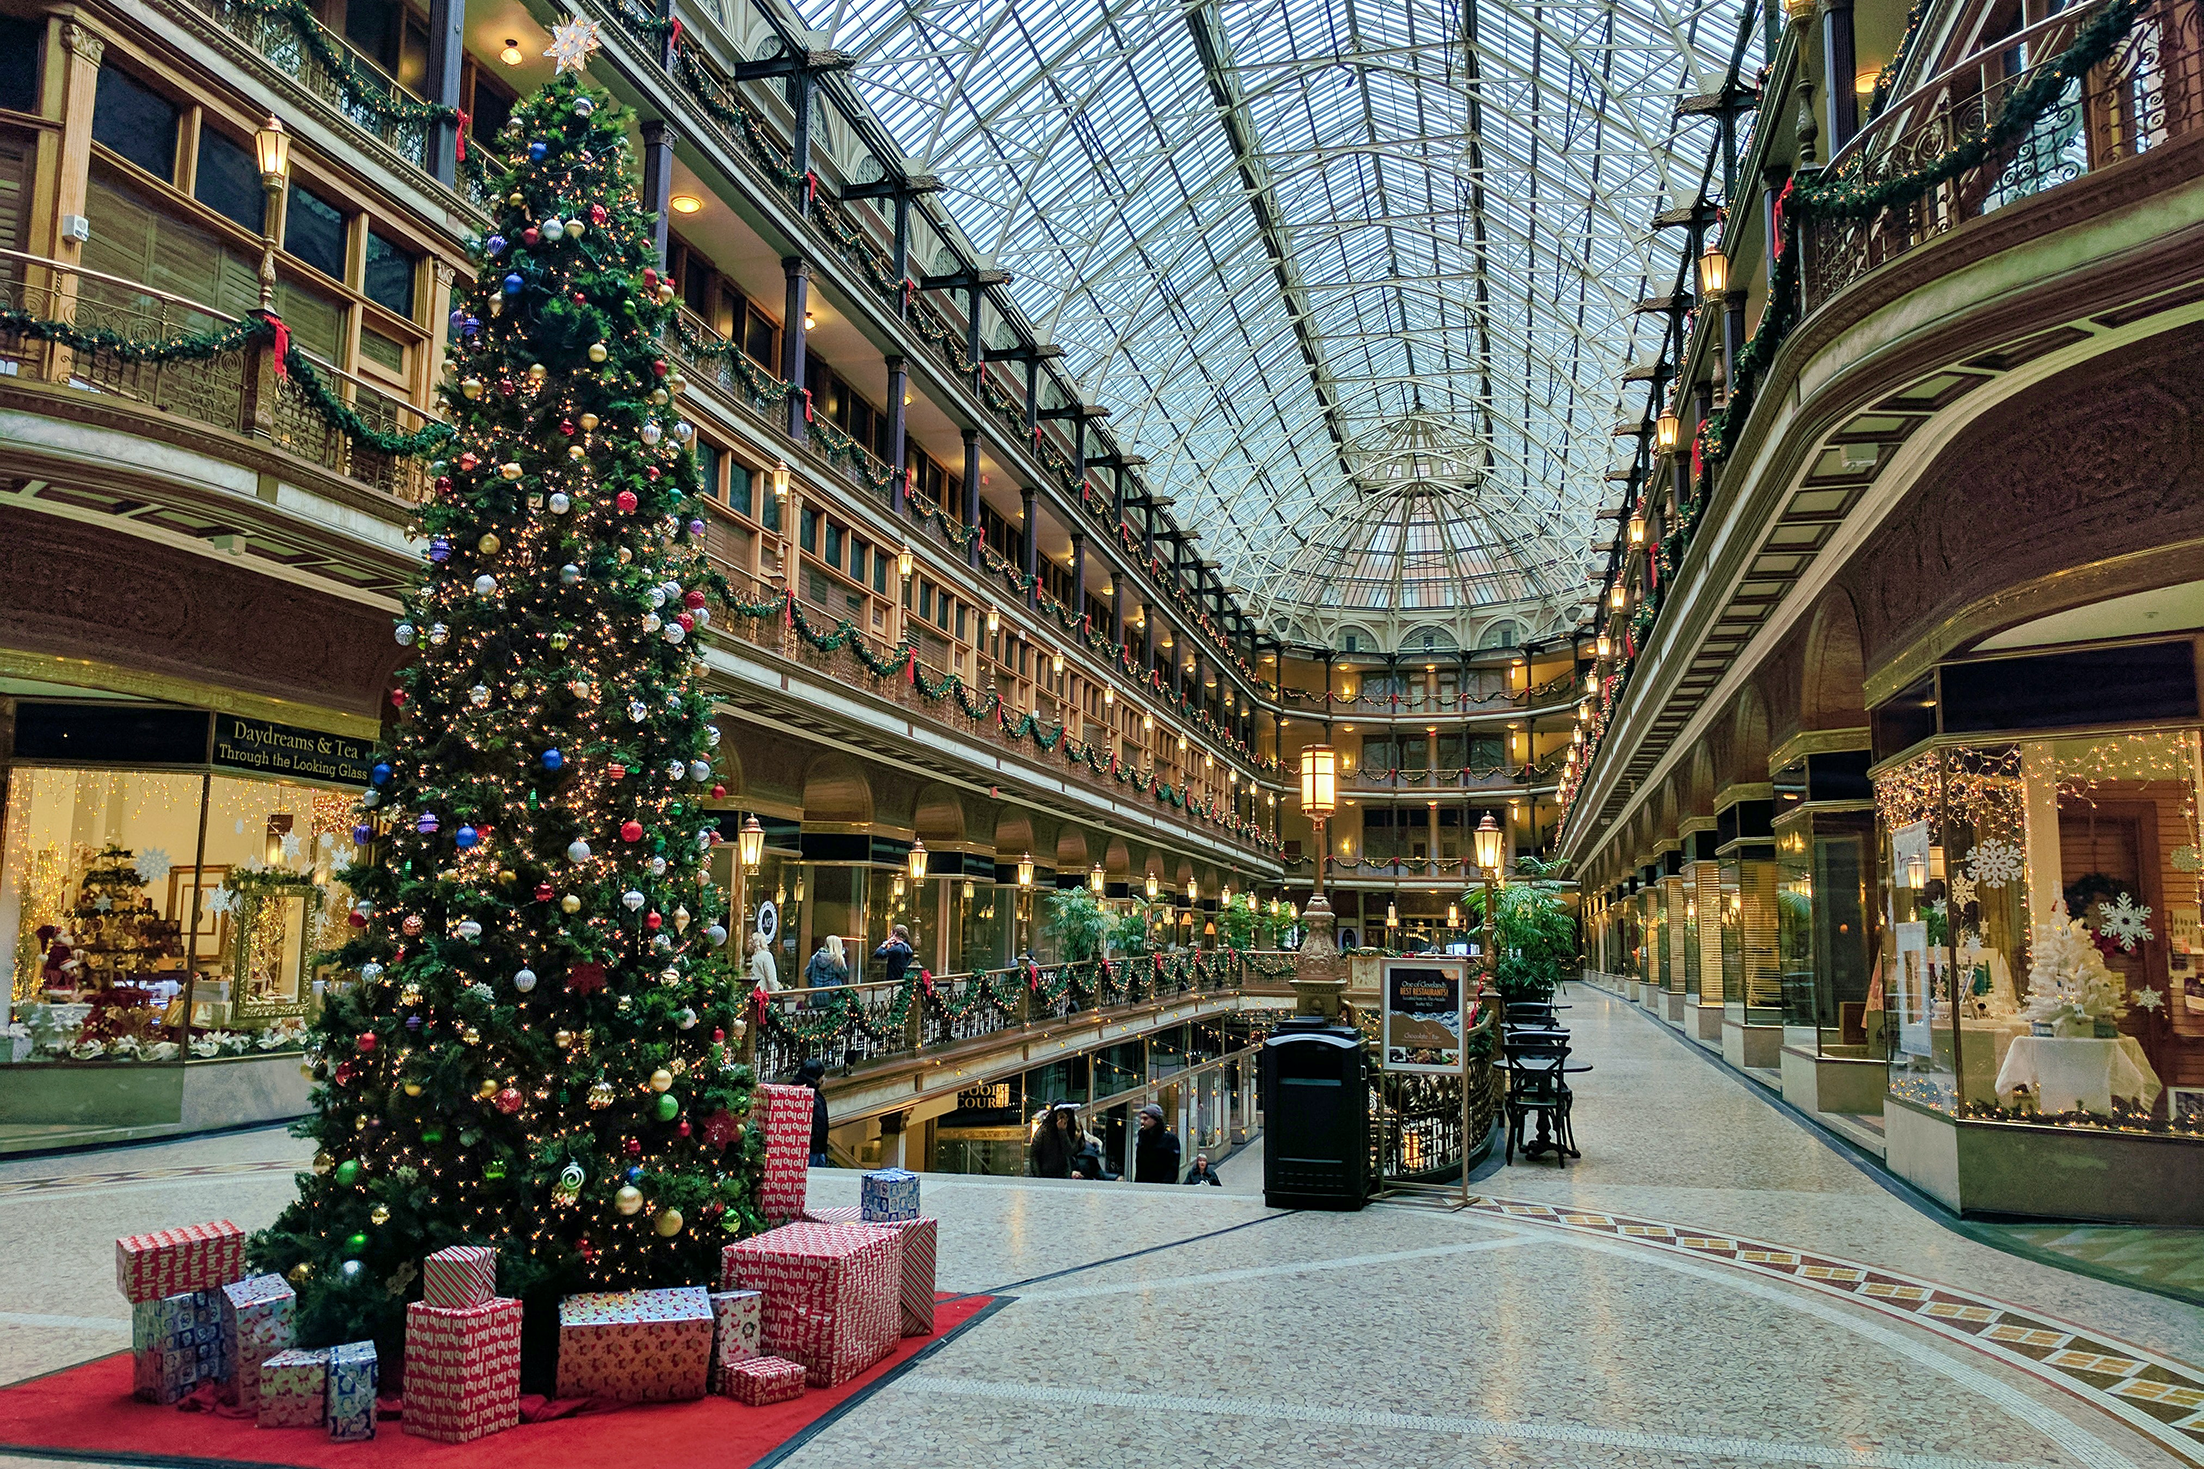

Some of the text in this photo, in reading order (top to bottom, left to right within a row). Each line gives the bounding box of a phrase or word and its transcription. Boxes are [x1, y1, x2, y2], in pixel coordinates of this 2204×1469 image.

[234, 721, 358, 760] Daydreams & Tea
[219, 743, 368, 780] Through the Looking Glass
[1400, 987, 1412, 996] BEST
[957, 1097, 1003, 1109] COUR
